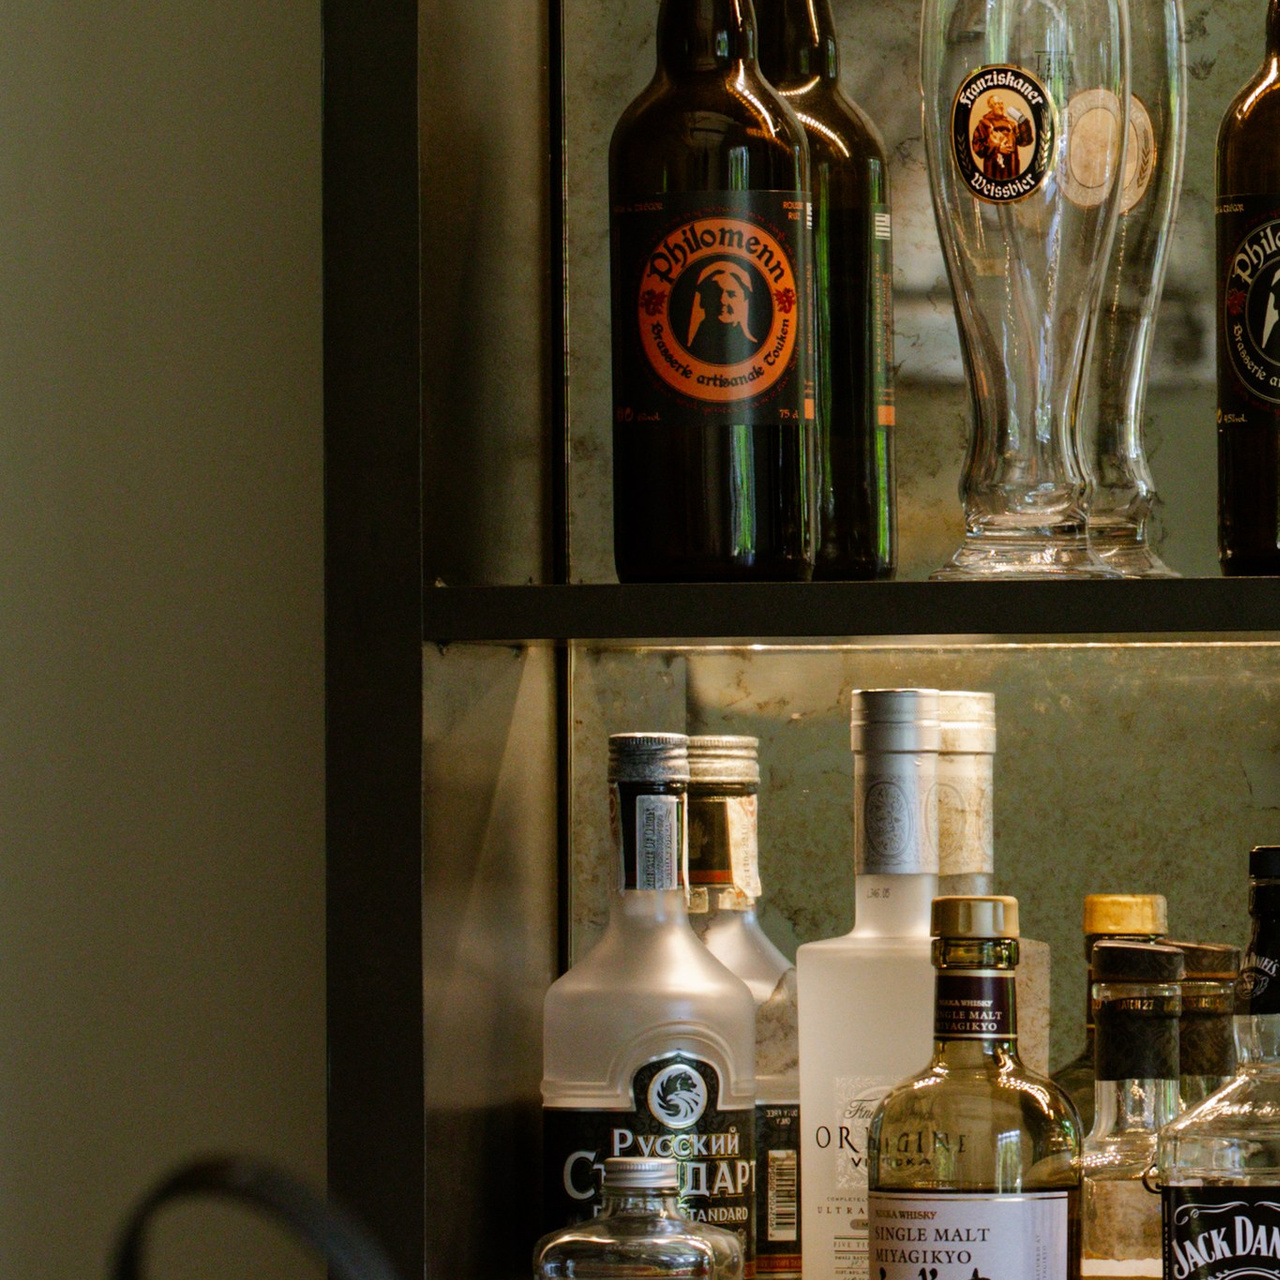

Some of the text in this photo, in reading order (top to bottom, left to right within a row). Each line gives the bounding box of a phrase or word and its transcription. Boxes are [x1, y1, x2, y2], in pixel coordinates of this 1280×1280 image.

[958, 70, 1044, 109] Franziskaner
[970, 171, 1036, 199] Weissbier
[647, 226, 786, 285] Philomenn
[651, 318, 790, 388] Brasserie artisanale Touken
[1234, 322, 1266, 381] Brasserie
[968, 1010, 1003, 1020] MALT
[611, 1125, 741, 1159] Русский
[817, 1206, 865, 1214] ULTRA
[874, 1226, 990, 1242] SINGLE MALT
[875, 1249, 972, 1265] MIYAGIKYO
[1171, 1226, 1234, 1280] JACK
